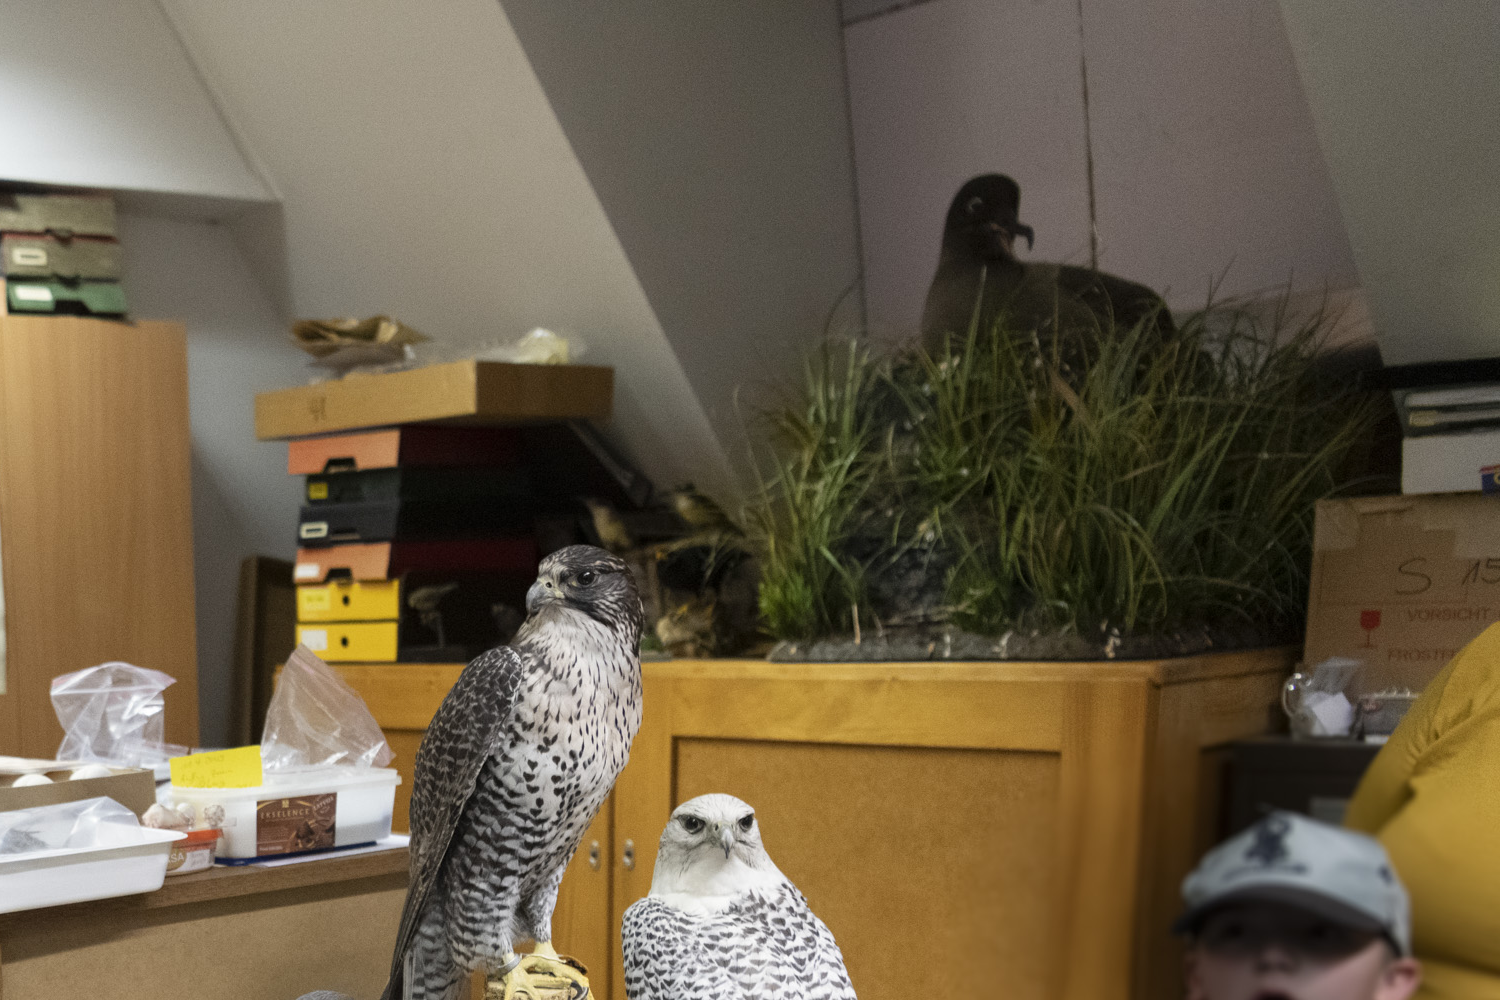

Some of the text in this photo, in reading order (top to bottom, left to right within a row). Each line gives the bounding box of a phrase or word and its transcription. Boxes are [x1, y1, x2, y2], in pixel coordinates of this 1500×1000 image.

[1407, 607, 1491, 622] VORSICHT
[1387, 648, 1458, 662] FROSTF
[260, 808, 310, 819] EKSELENCE
